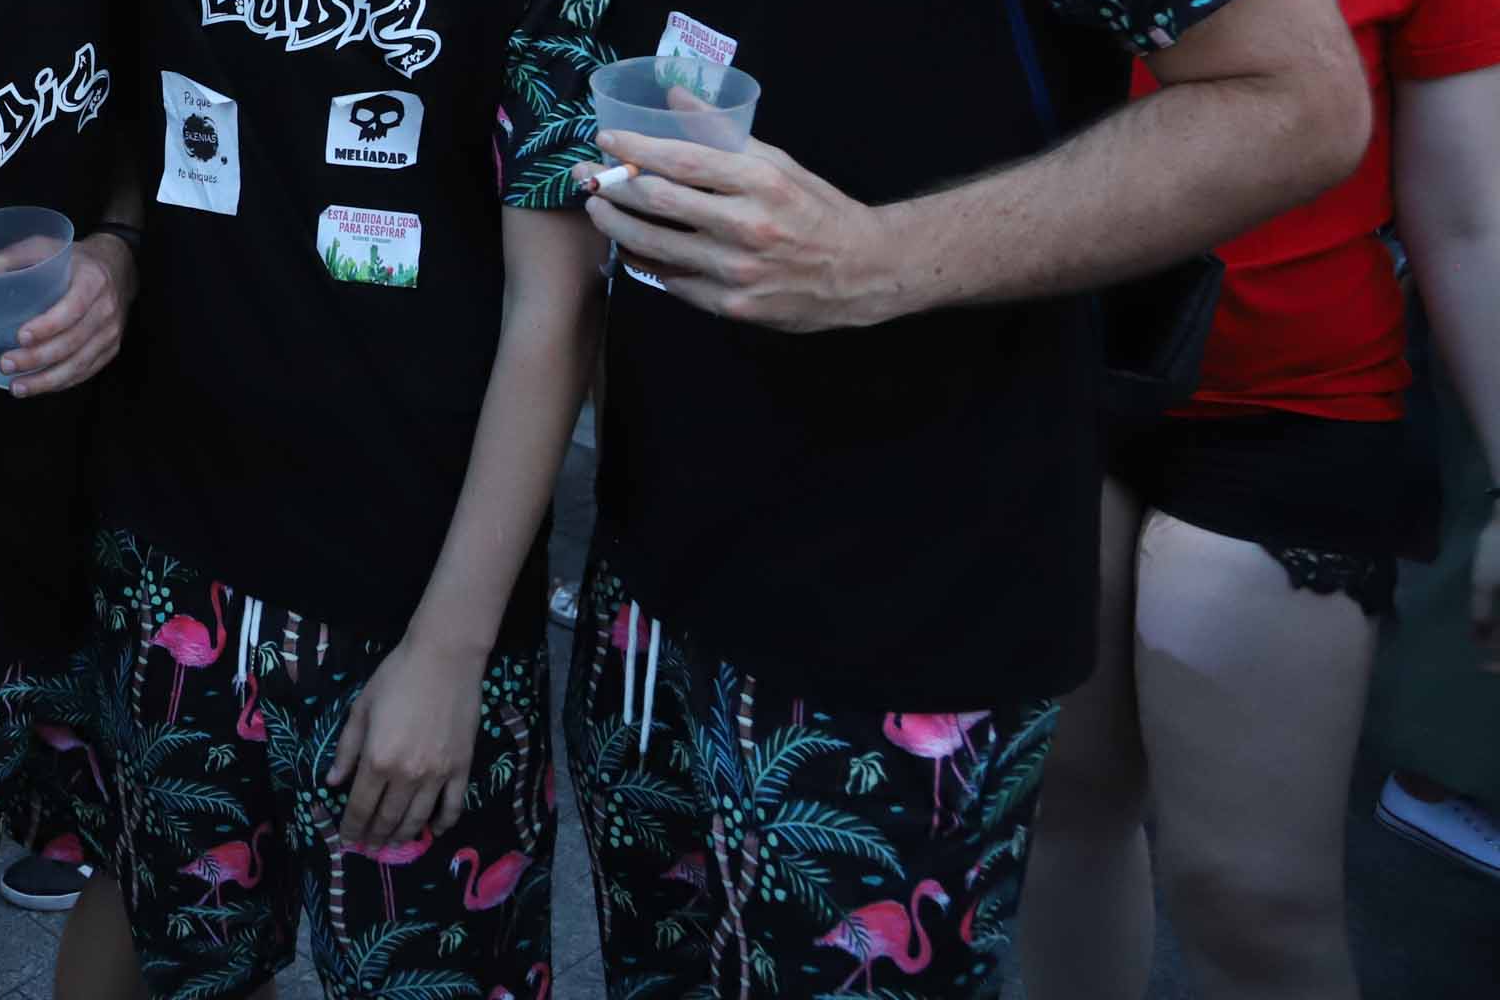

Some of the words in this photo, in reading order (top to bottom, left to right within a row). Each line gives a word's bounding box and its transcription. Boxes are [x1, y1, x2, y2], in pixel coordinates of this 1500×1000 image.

[196, 98, 212, 110] que
[334, 147, 408, 165] MELÍADAR
[327, 208, 348, 221] ESTÁ
[352, 211, 382, 225] JODIDA
[384, 215, 394, 226] LA
[397, 216, 419, 228] COSA
[339, 222, 361, 234] PARA
[363, 225, 406, 239] RESPIRAR
